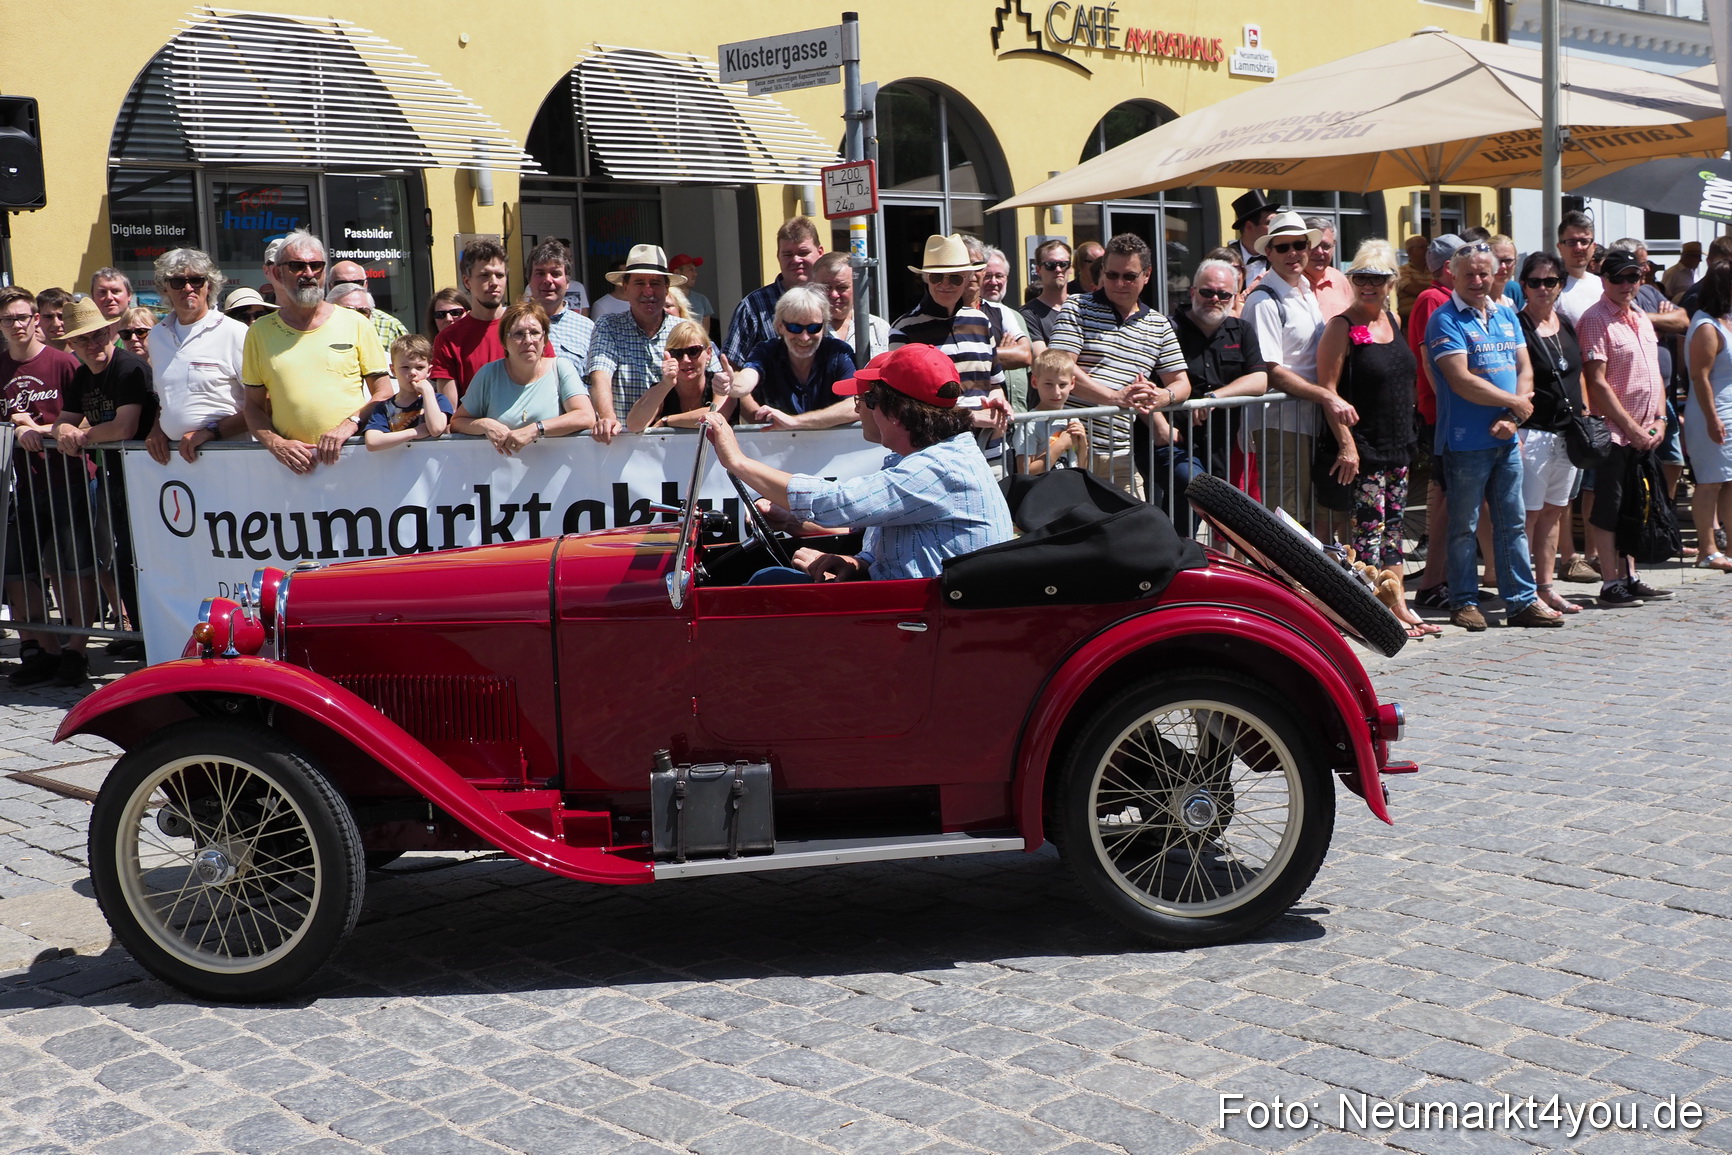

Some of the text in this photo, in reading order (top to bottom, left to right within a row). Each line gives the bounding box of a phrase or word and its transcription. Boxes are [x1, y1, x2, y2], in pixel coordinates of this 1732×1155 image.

[1047, 1, 1120, 50] CAFÉ
[726, 40, 828, 72] Klostergasse
[841, 168, 860, 181] 200
[223, 210, 300, 230] hailer
[1485, 212, 1496, 228] 24
[111, 223, 186, 237] Digitale Bilder
[344, 228, 394, 239] Passbilder
[329, 248, 411, 261] Bewerbungsbilder
[365, 268, 386, 278] ofort
